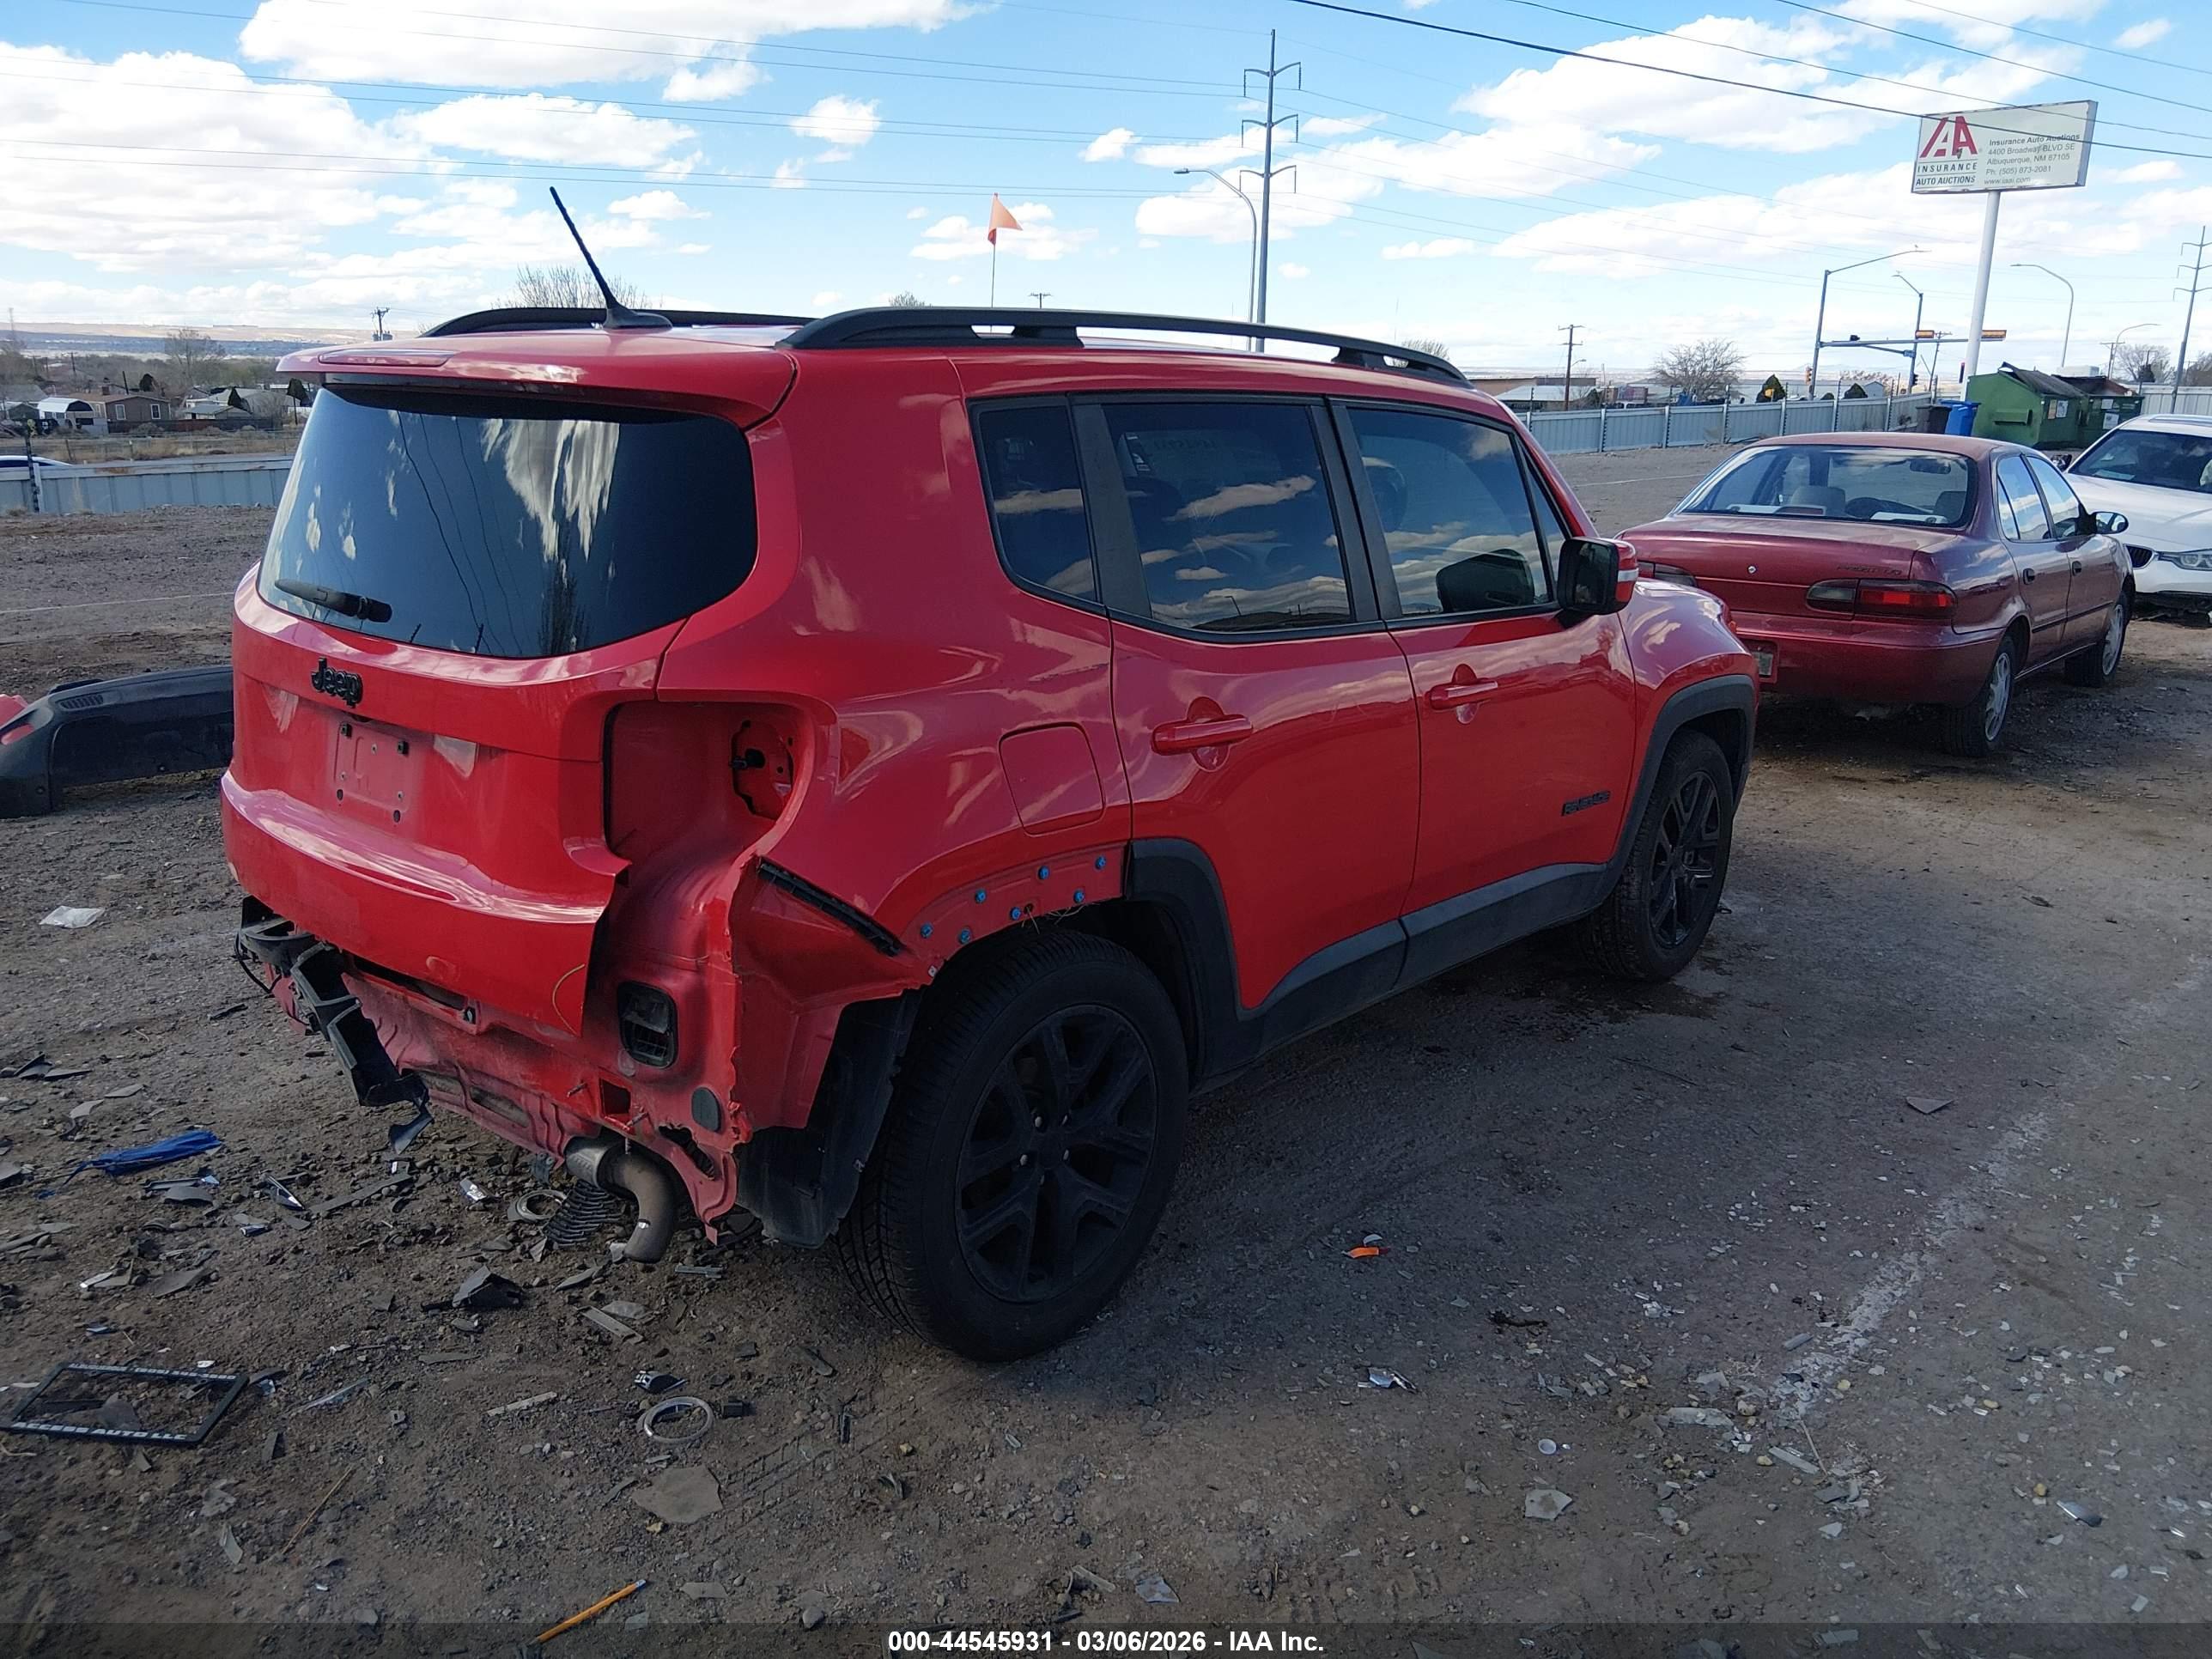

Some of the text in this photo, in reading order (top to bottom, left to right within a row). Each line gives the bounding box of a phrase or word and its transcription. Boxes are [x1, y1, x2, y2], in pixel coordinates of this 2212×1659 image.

[1990, 137, 2026, 146] Insurance
[1917, 162, 1978, 173] INSURANCE
[1916, 175, 1976, 185] AUTO AUCTIONS
[311, 657, 364, 708] Jeep
[91, 1428, 149, 1437] AUTO
